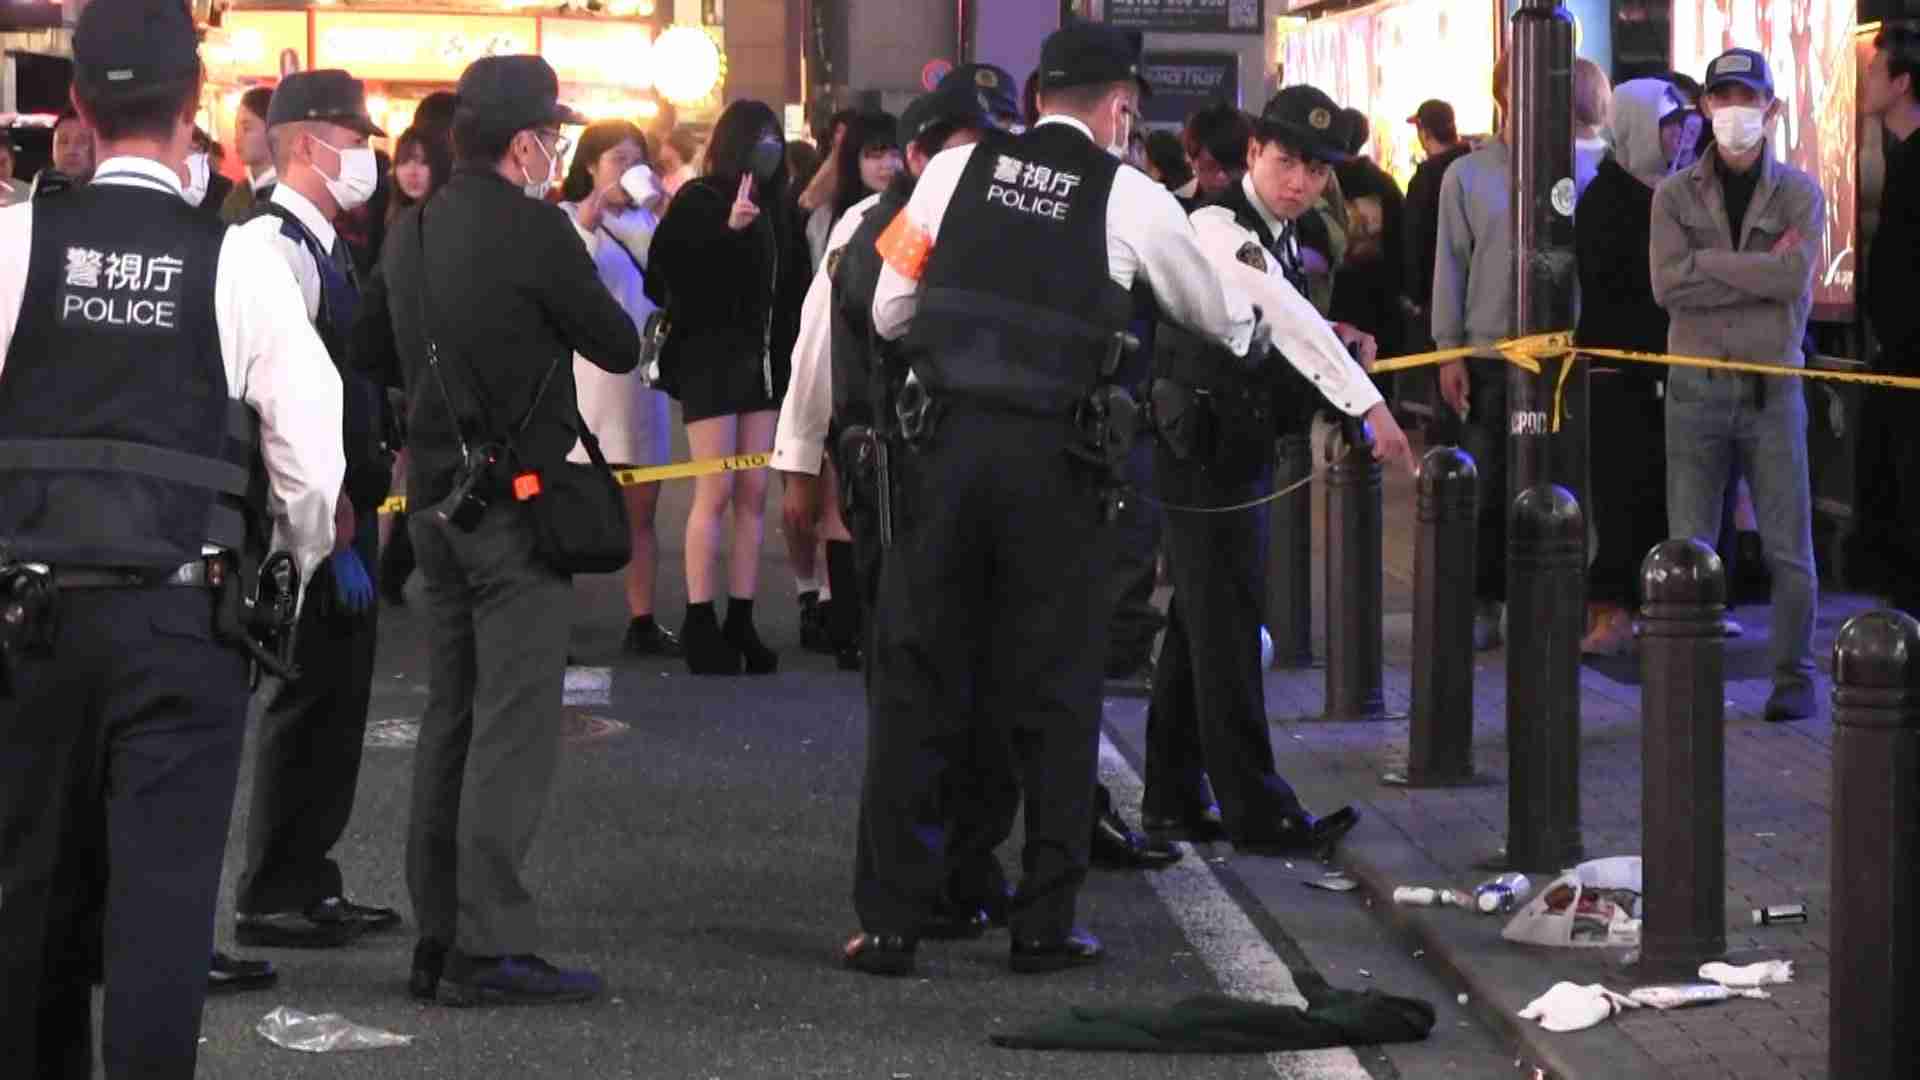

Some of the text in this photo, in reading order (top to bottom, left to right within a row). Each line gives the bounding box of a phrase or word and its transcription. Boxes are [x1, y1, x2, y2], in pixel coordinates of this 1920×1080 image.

[993, 154, 1081, 197] 警視庁
[986, 184, 1070, 220] POLICE
[65, 247, 184, 292] 警視庁
[63, 294, 175, 328] POLICE
